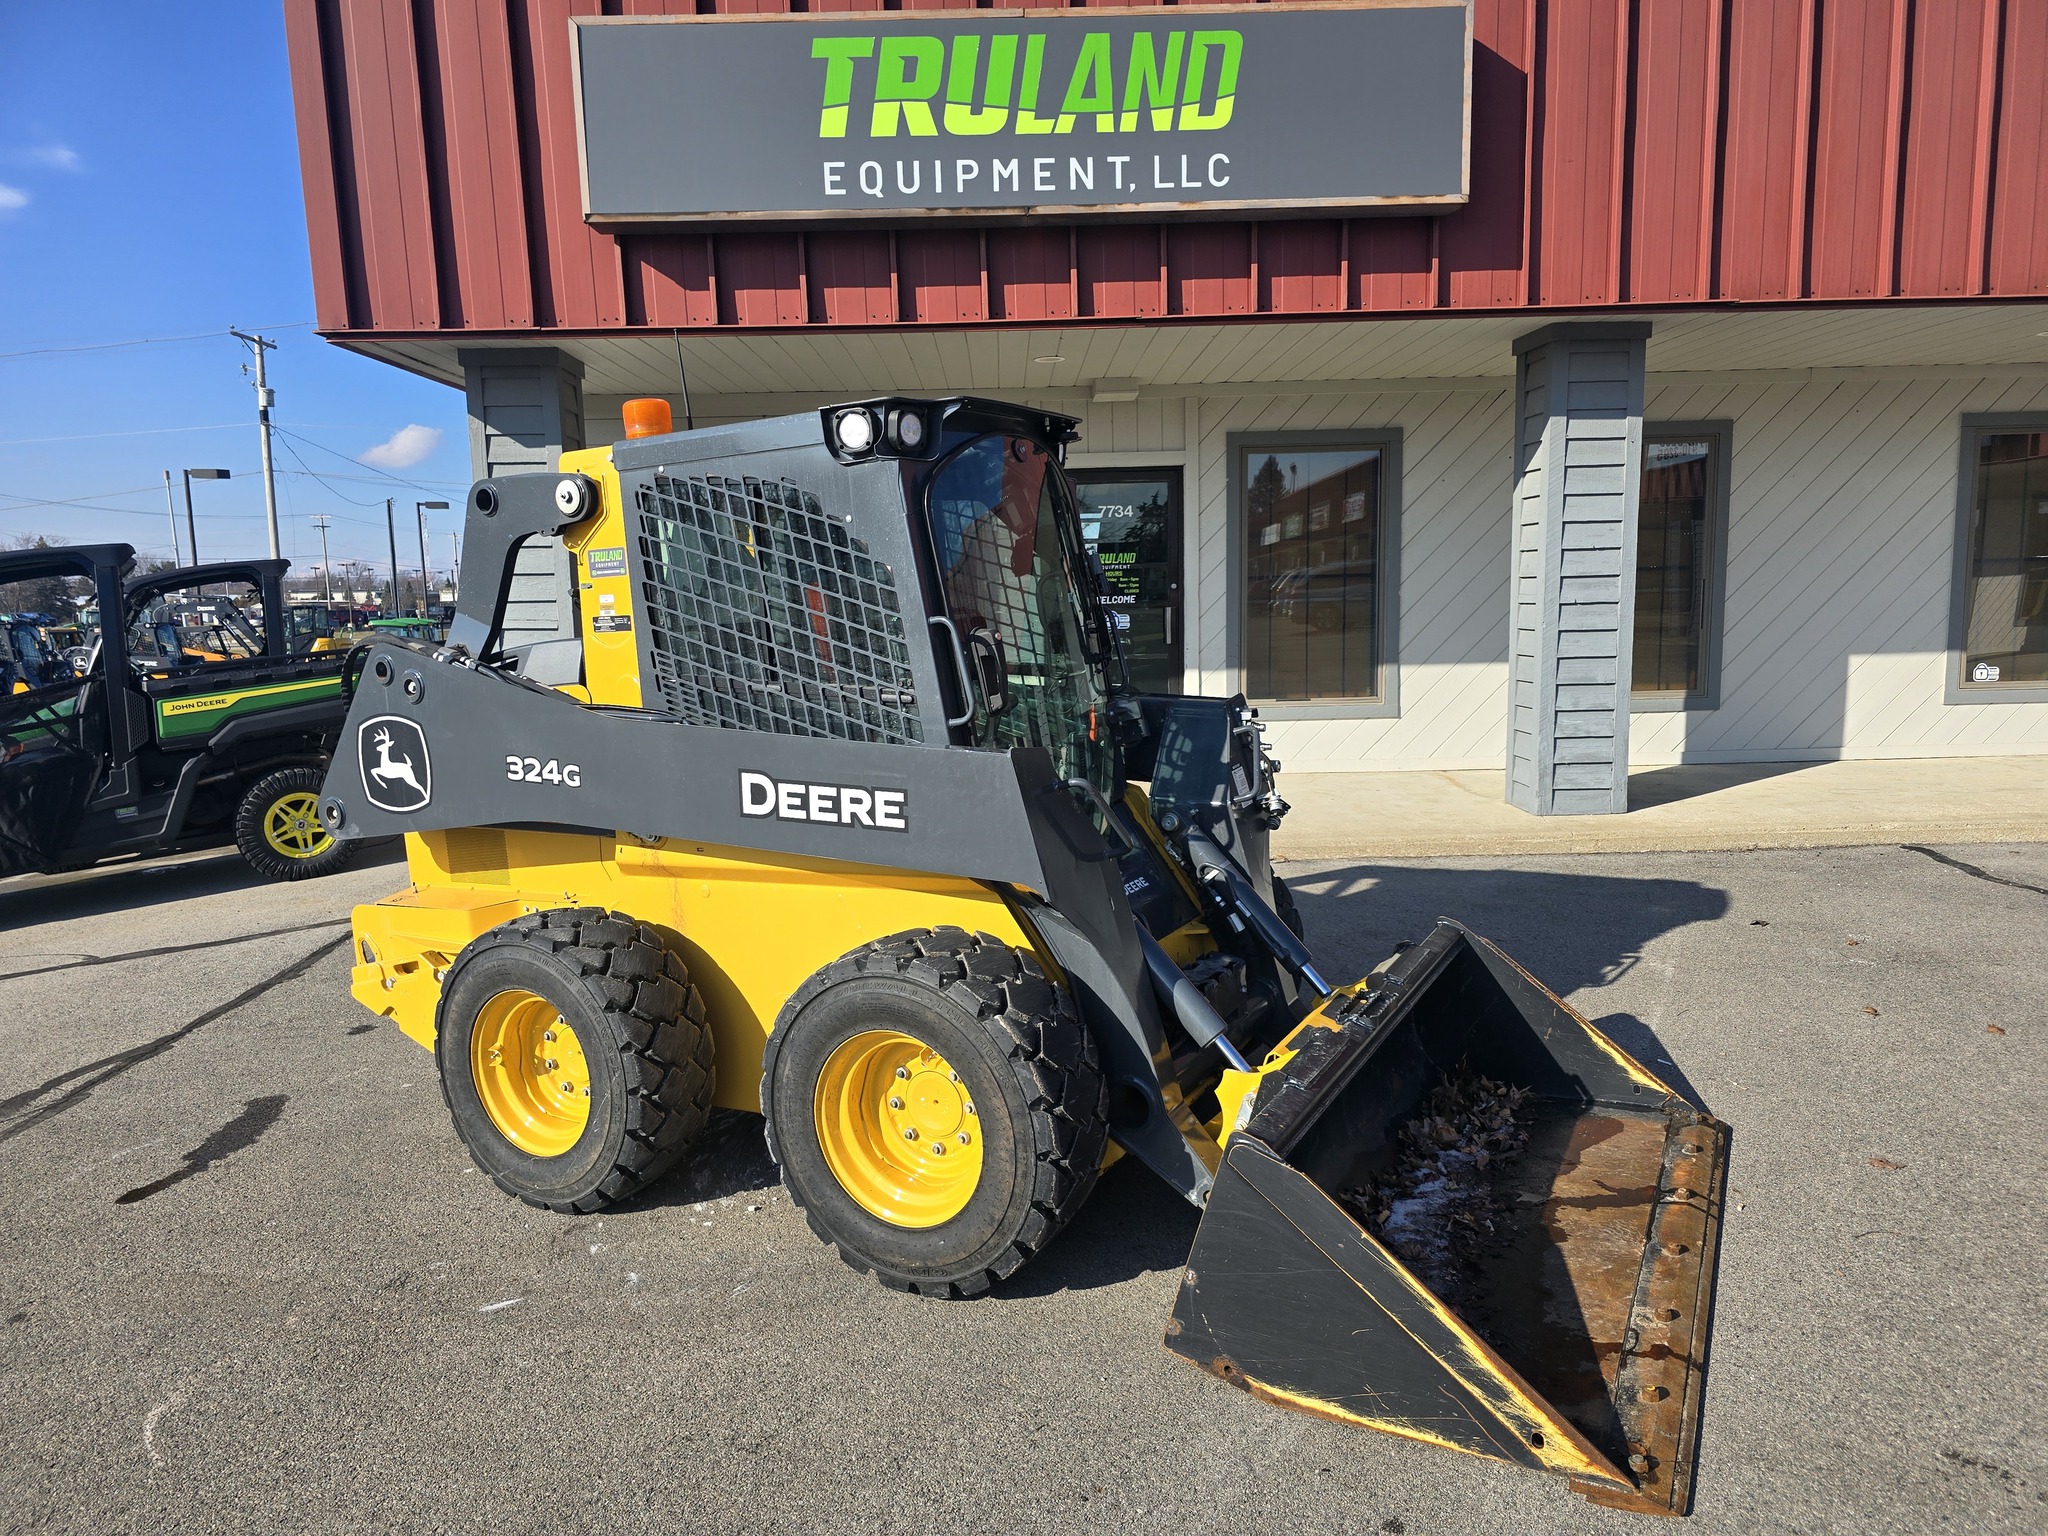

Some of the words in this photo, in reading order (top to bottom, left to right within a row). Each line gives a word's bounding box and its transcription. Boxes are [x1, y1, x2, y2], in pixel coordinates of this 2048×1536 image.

[811, 30, 1244, 138] TRULAND
[823, 156, 1136, 198] EQUIPMENT,
[1154, 153, 1231, 188] LLC
[1098, 505, 1134, 518] 7734
[590, 550, 623, 562] TRULAND
[1098, 552, 1137, 564] RULAND
[170, 702, 195, 712] JOHN
[196, 698, 228, 708] DEERE
[506, 756, 581, 787] 324G
[741, 773, 906, 828] DEERE
